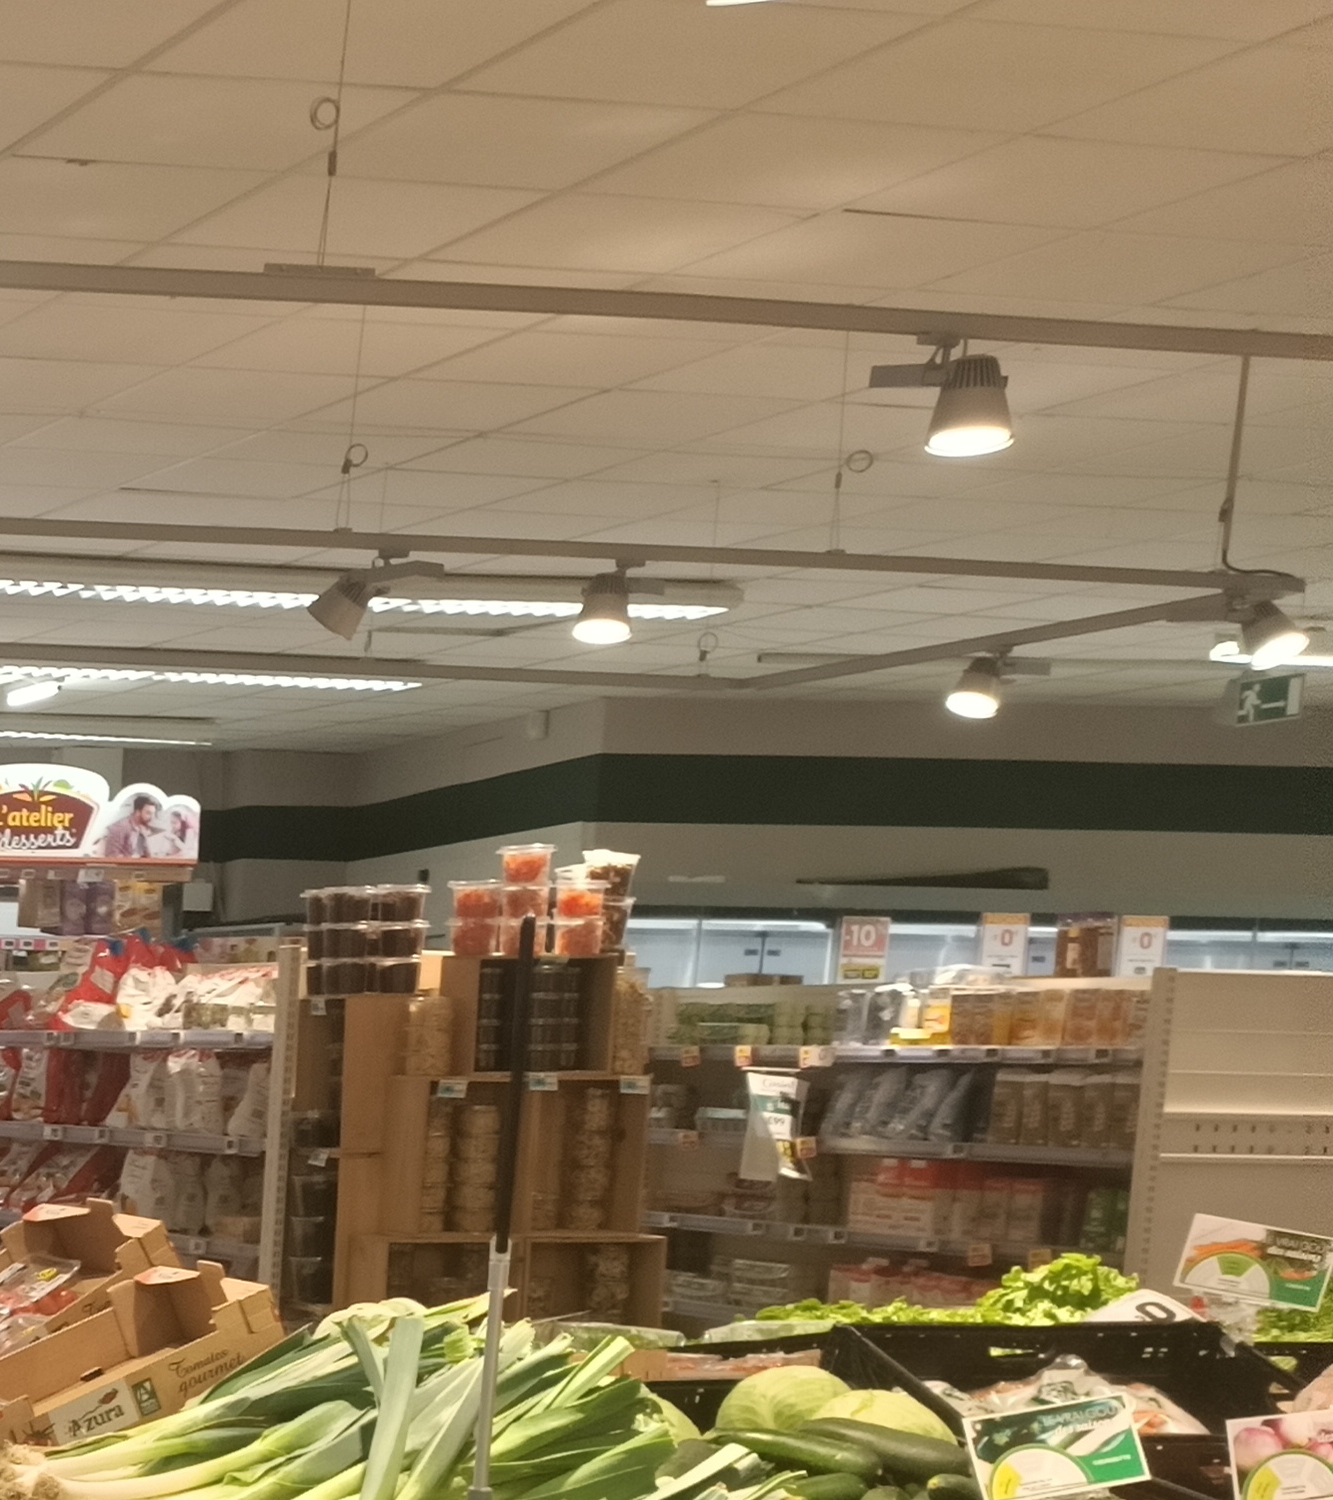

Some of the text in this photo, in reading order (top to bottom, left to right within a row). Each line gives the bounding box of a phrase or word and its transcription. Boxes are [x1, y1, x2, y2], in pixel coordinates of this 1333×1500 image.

[0, 828, 77, 850] desserts
[168, 1348, 230, 1379] Tomates
[177, 1352, 244, 1396] gourmet
[68, 1402, 125, 1437] Azura
